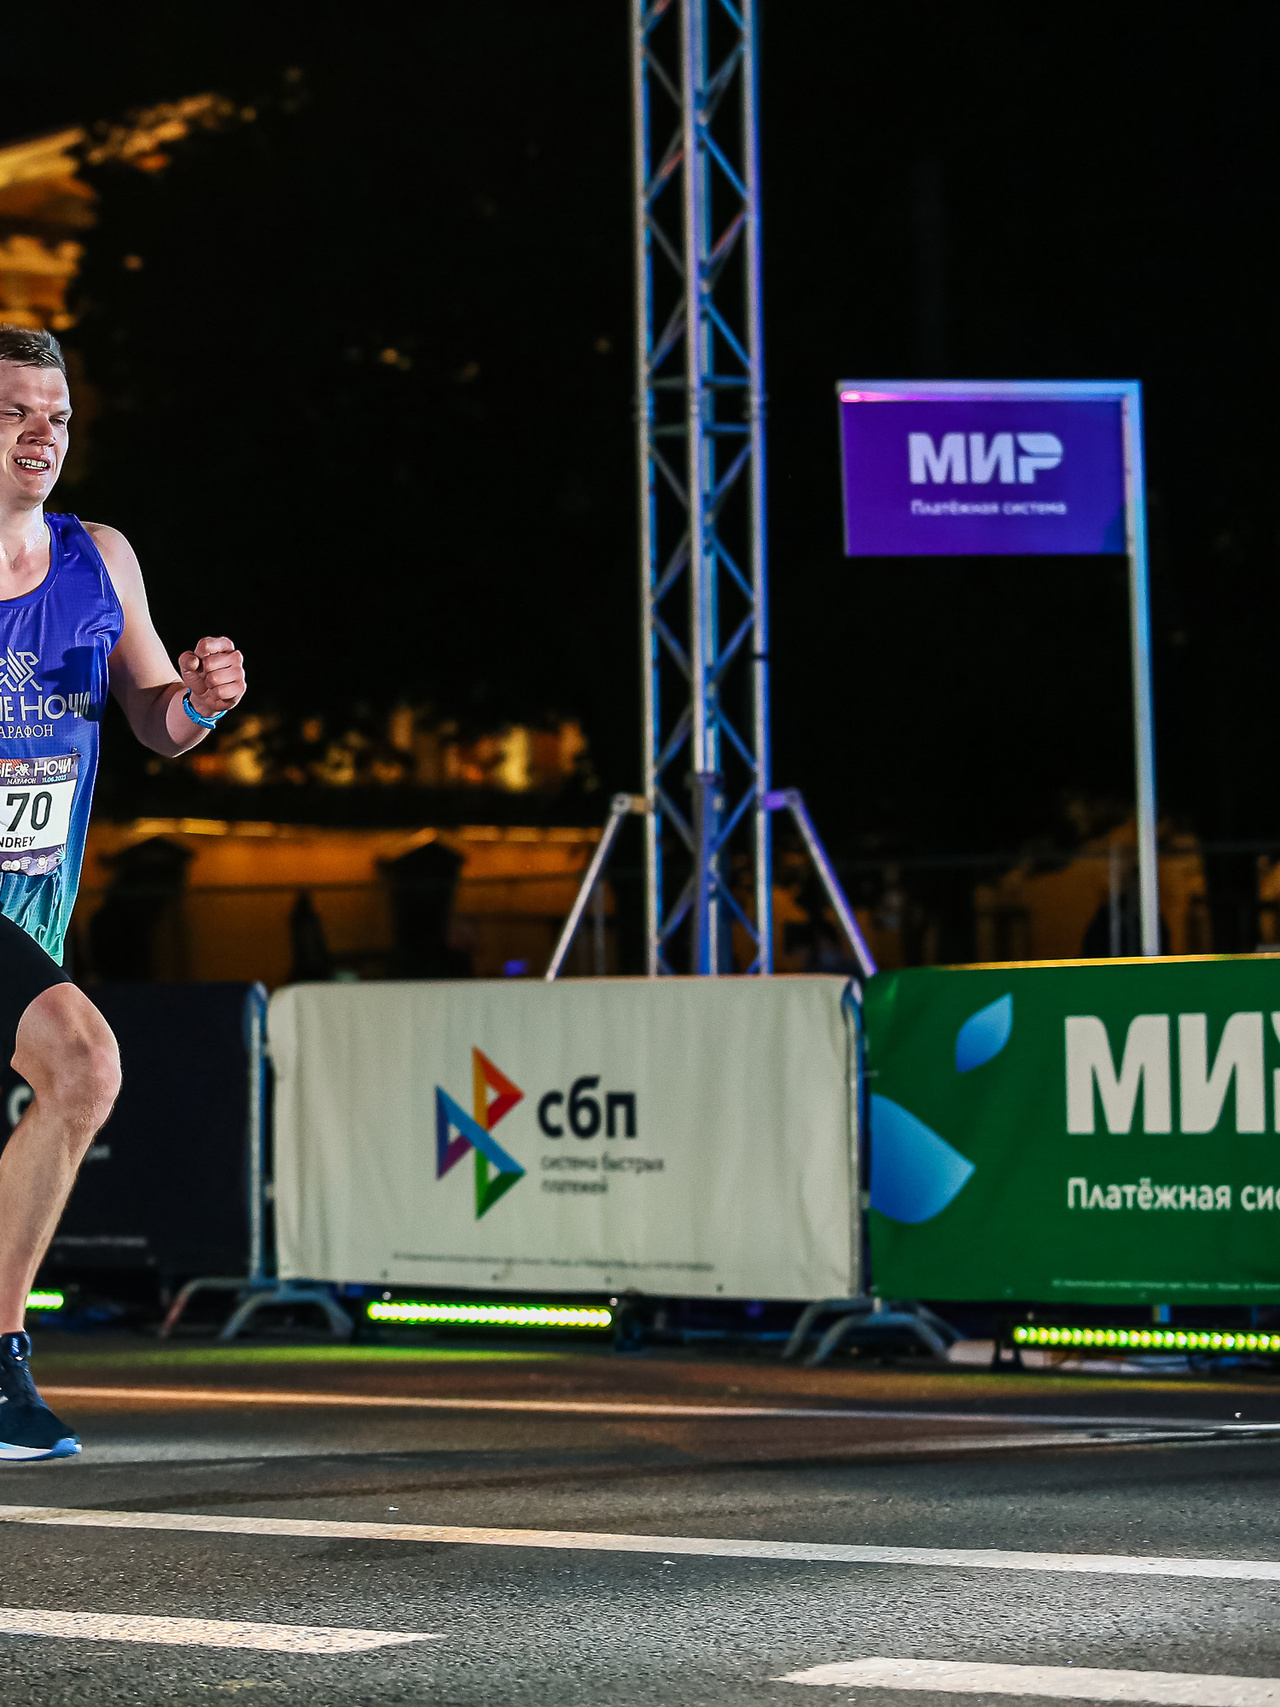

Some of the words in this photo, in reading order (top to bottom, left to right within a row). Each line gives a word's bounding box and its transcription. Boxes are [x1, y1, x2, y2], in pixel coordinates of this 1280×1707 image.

[908, 431, 1064, 484] МИР
[20, 691, 91, 721] НОЧИ
[33, 757, 72, 777] НОЧИ
[1064, 1011, 1280, 1135] МИ
[1067, 1177, 1232, 1211] Платёжная
